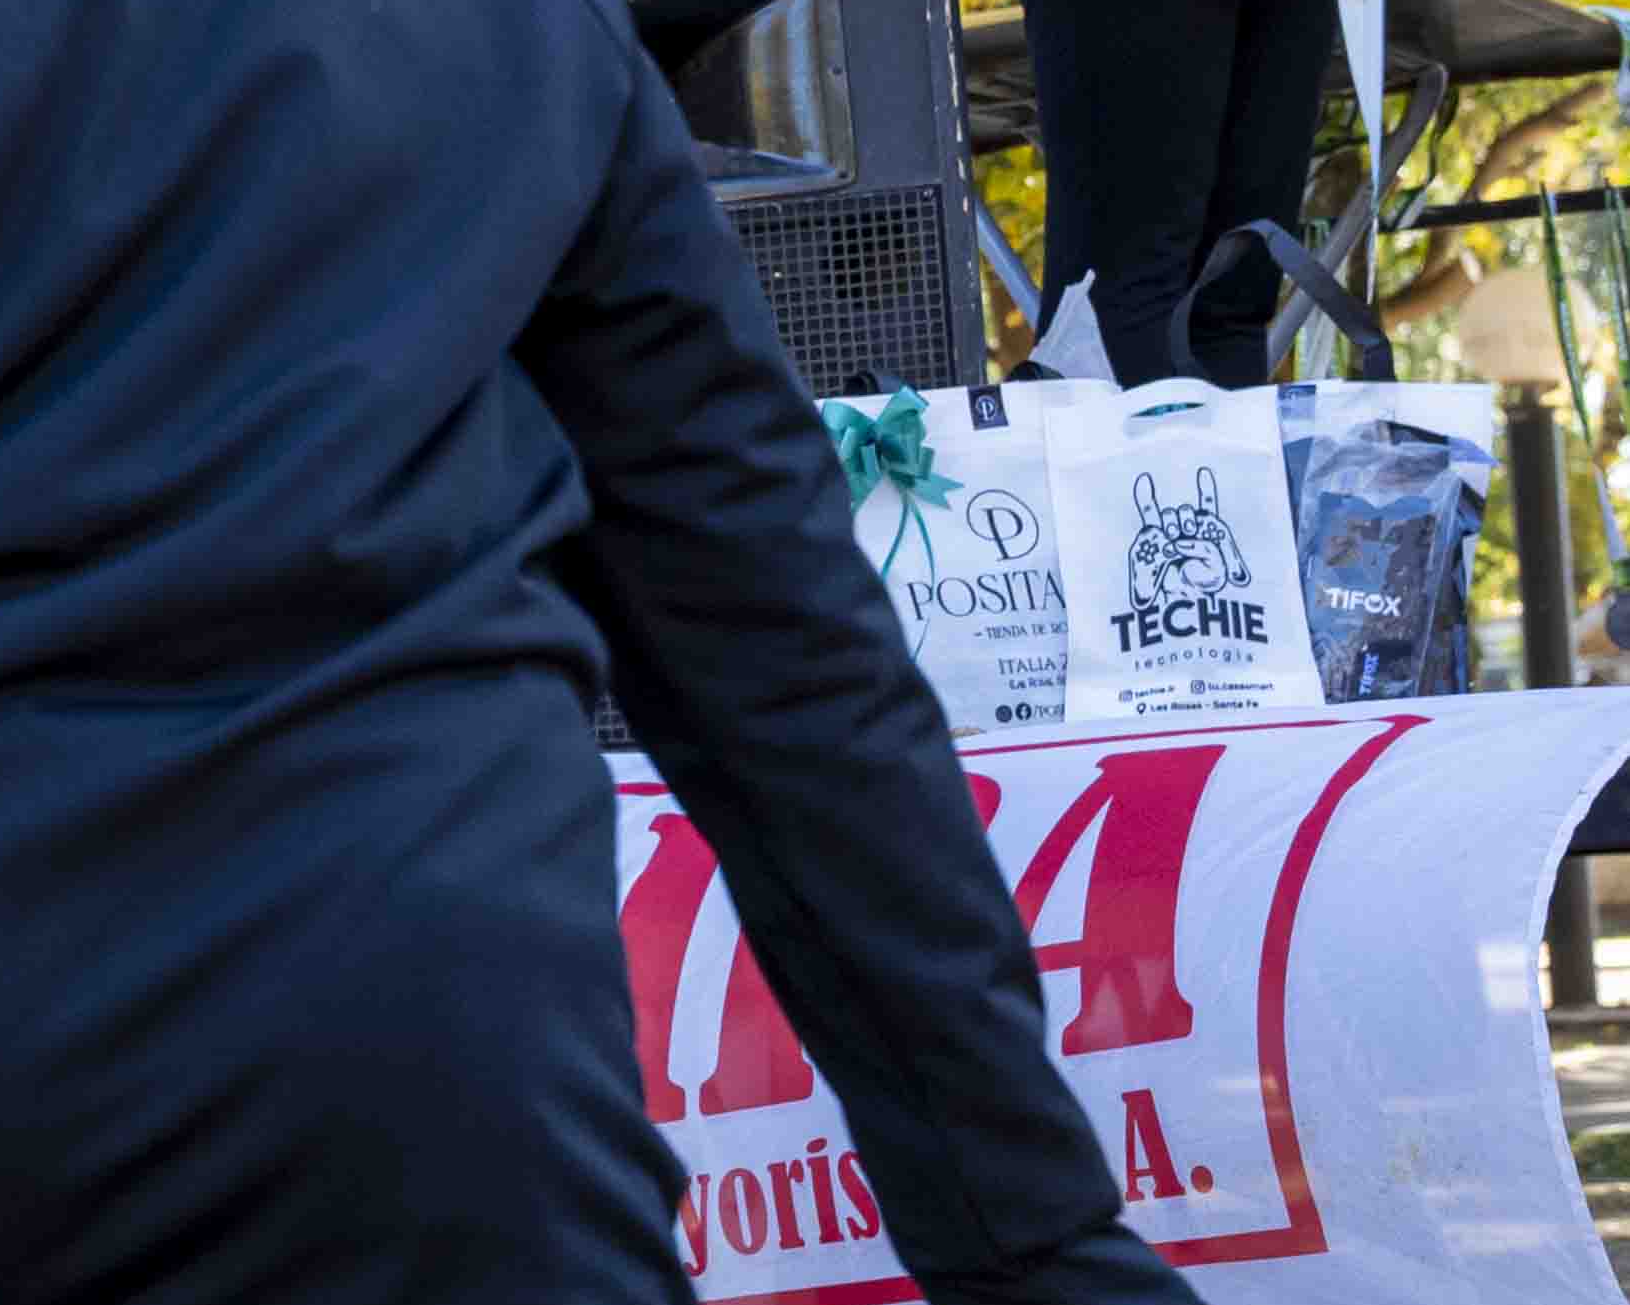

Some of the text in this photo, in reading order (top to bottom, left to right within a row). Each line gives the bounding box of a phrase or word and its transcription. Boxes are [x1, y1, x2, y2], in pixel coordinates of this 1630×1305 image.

[907, 567, 1067, 622] POSITA
[1325, 587, 1403, 617] TIFOX
[1051, 622, 1069, 635] RO
[1110, 597, 1269, 654] TECHIE
[998, 656, 1056, 676] ITALIA
[676, 1137, 881, 1277] yoris
